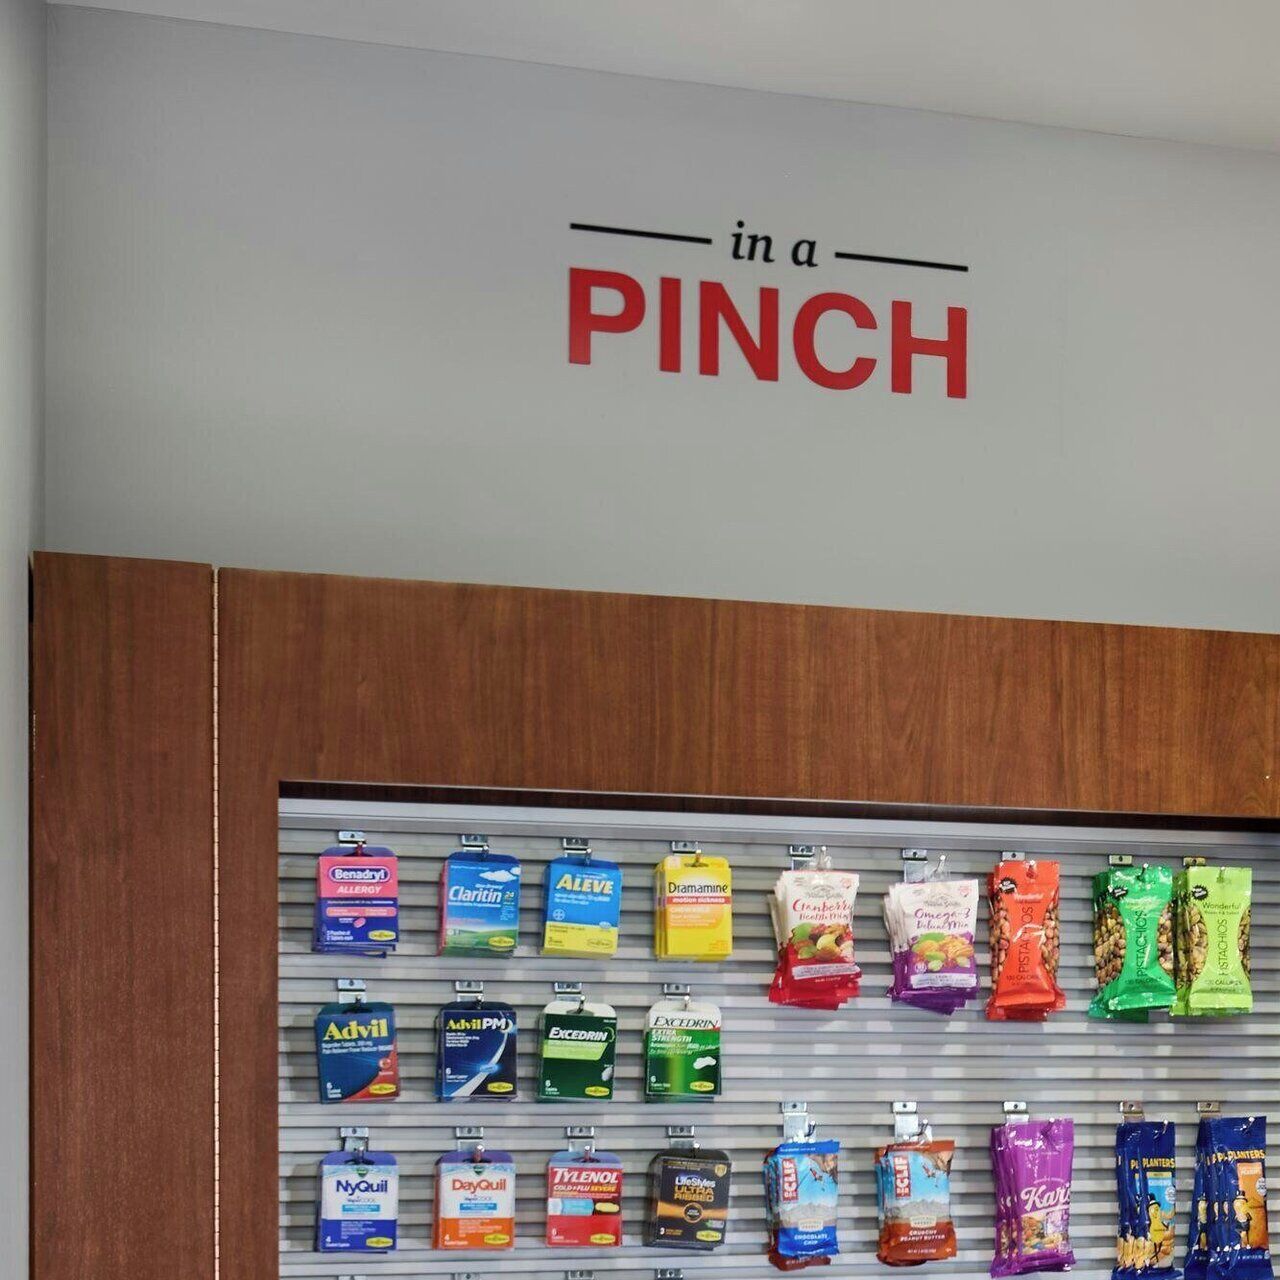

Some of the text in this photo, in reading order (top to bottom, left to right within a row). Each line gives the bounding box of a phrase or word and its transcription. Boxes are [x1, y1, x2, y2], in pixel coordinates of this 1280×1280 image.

[731, 221, 819, 268] in a
[569, 267, 968, 399] PINCH
[335, 868, 386, 883] Benadryl
[337, 886, 382, 894] ALLERGY
[555, 874, 614, 895] ALEVE
[668, 881, 728, 895] Dramamine
[449, 886, 502, 903] Claritin
[446, 1018, 507, 1031] Advil PM
[654, 1016, 719, 1028] EXCEDRIN
[323, 1019, 389, 1041] Advil
[548, 1026, 609, 1042] EXCEDRIN
[1227, 1149, 1266, 1161] PLANTERS
[1142, 1158, 1175, 1169] PLANTERS
[553, 1168, 619, 1184] TYLENOL
[336, 1180, 387, 1194] NyQuil
[452, 1178, 507, 1194] DayQuil
